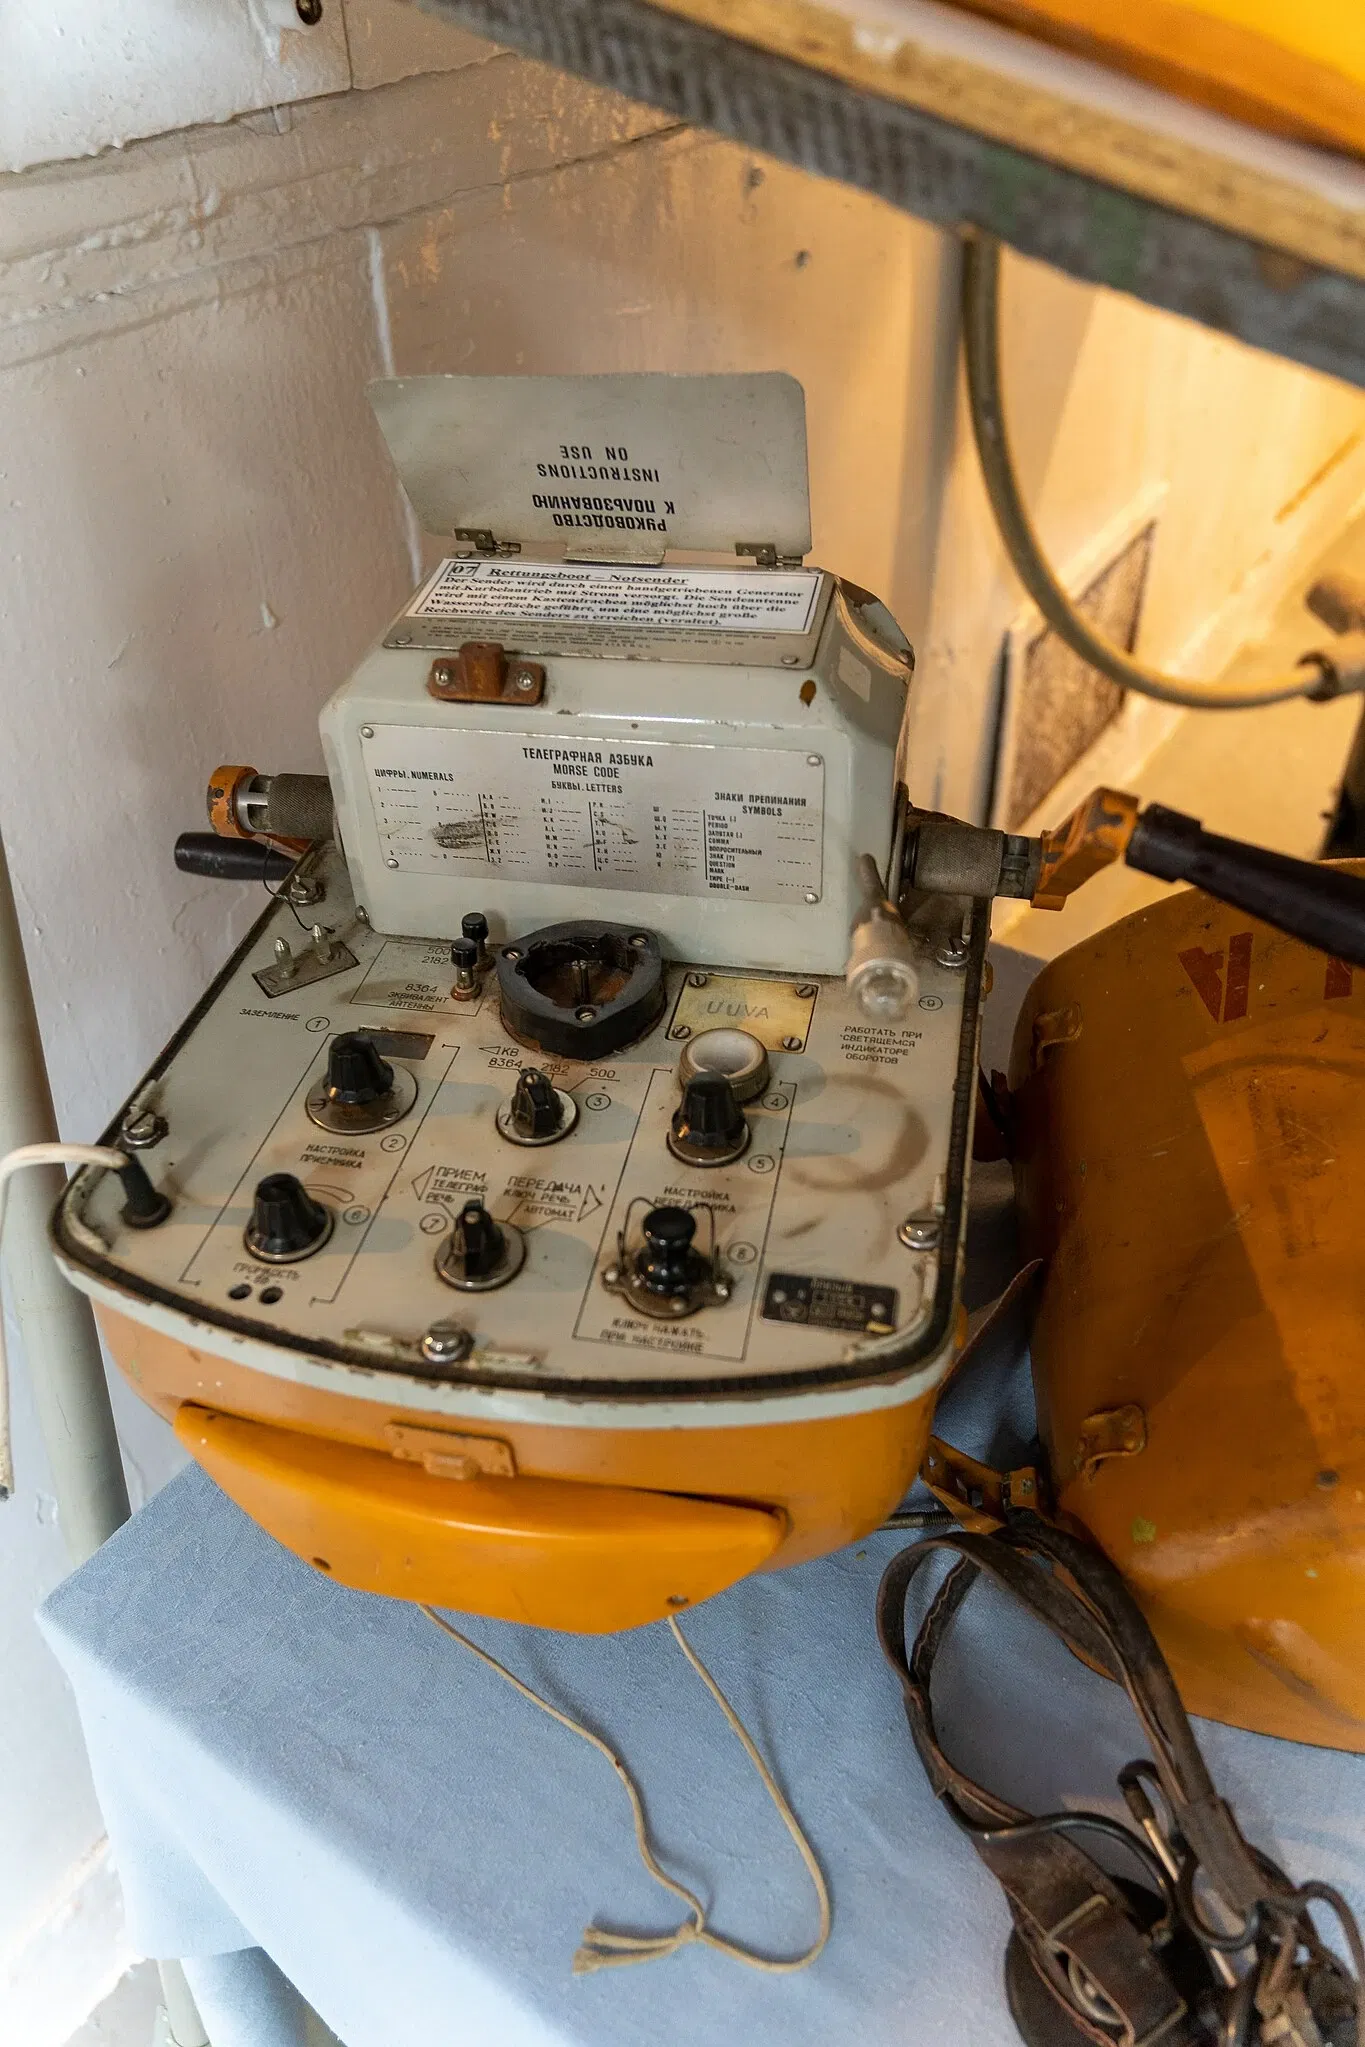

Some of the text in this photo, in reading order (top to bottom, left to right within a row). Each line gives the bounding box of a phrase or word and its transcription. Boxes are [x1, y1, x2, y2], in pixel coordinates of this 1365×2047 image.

[559, 445, 628, 461] ON USE
[536, 463, 660, 482] INSTRUCTIONS
[532, 494, 675, 514] К ПОЛЬЗОВАНИЮ
[553, 514, 667, 531] РУКОВОДСТВО
[452, 566, 478, 574] 07
[489, 568, 591, 580] Rettungsboot
[610, 574, 689, 584] Notsender
[471, 577, 514, 585] Sender
[627, 585, 732, 594] handgetriebenen
[736, 588, 804, 597] Generator
[532, 596, 627, 605] Kastendrachen
[709, 596, 800, 605] Sendeantenne
[424, 606, 492, 614] Reichweite
[431, 599, 541, 609] Wasseroberfläche
[544, 604, 594, 612] geführt,
[653, 609, 716, 617] möglichst
[522, 747, 654, 767] ТЕЛЕГРАФНАЯ АЗБУКА
[553, 764, 620, 778] MORSE CODE
[715, 792, 807, 807] ЗНАКИ ПРЕПИНАНИЯ
[742, 805, 783, 817] SYMBOLS
[427, 946, 451, 956] 500
[421, 956, 450, 965] 2182
[405, 983, 438, 993] 8364
[388, 991, 449, 1004] ЭКВИВАЛЕНТ
[388, 1000, 435, 1011] АНТЕННЫ
[239, 1008, 300, 1021] ЗАЗЕМЛЕНИЕ
[844, 1025, 923, 1039] РАБОТАТЬ ПРИ
[842, 1034, 916, 1047] СВЕТЯЩЕМСЯ
[840, 1043, 909, 1056] ИНДИКАТОРЕ
[489, 1058, 522, 1069] 8364
[845, 1053, 898, 1064] ОБОРОТОВ
[542, 1062, 570, 1074] 2182
[590, 1068, 616, 1079] 500
[306, 1144, 365, 1158] НАСТРОЙКА
[436, 1166, 486, 1181] ПРИЕМ
[507, 1176, 581, 1194] ПЕРЕДАЧА
